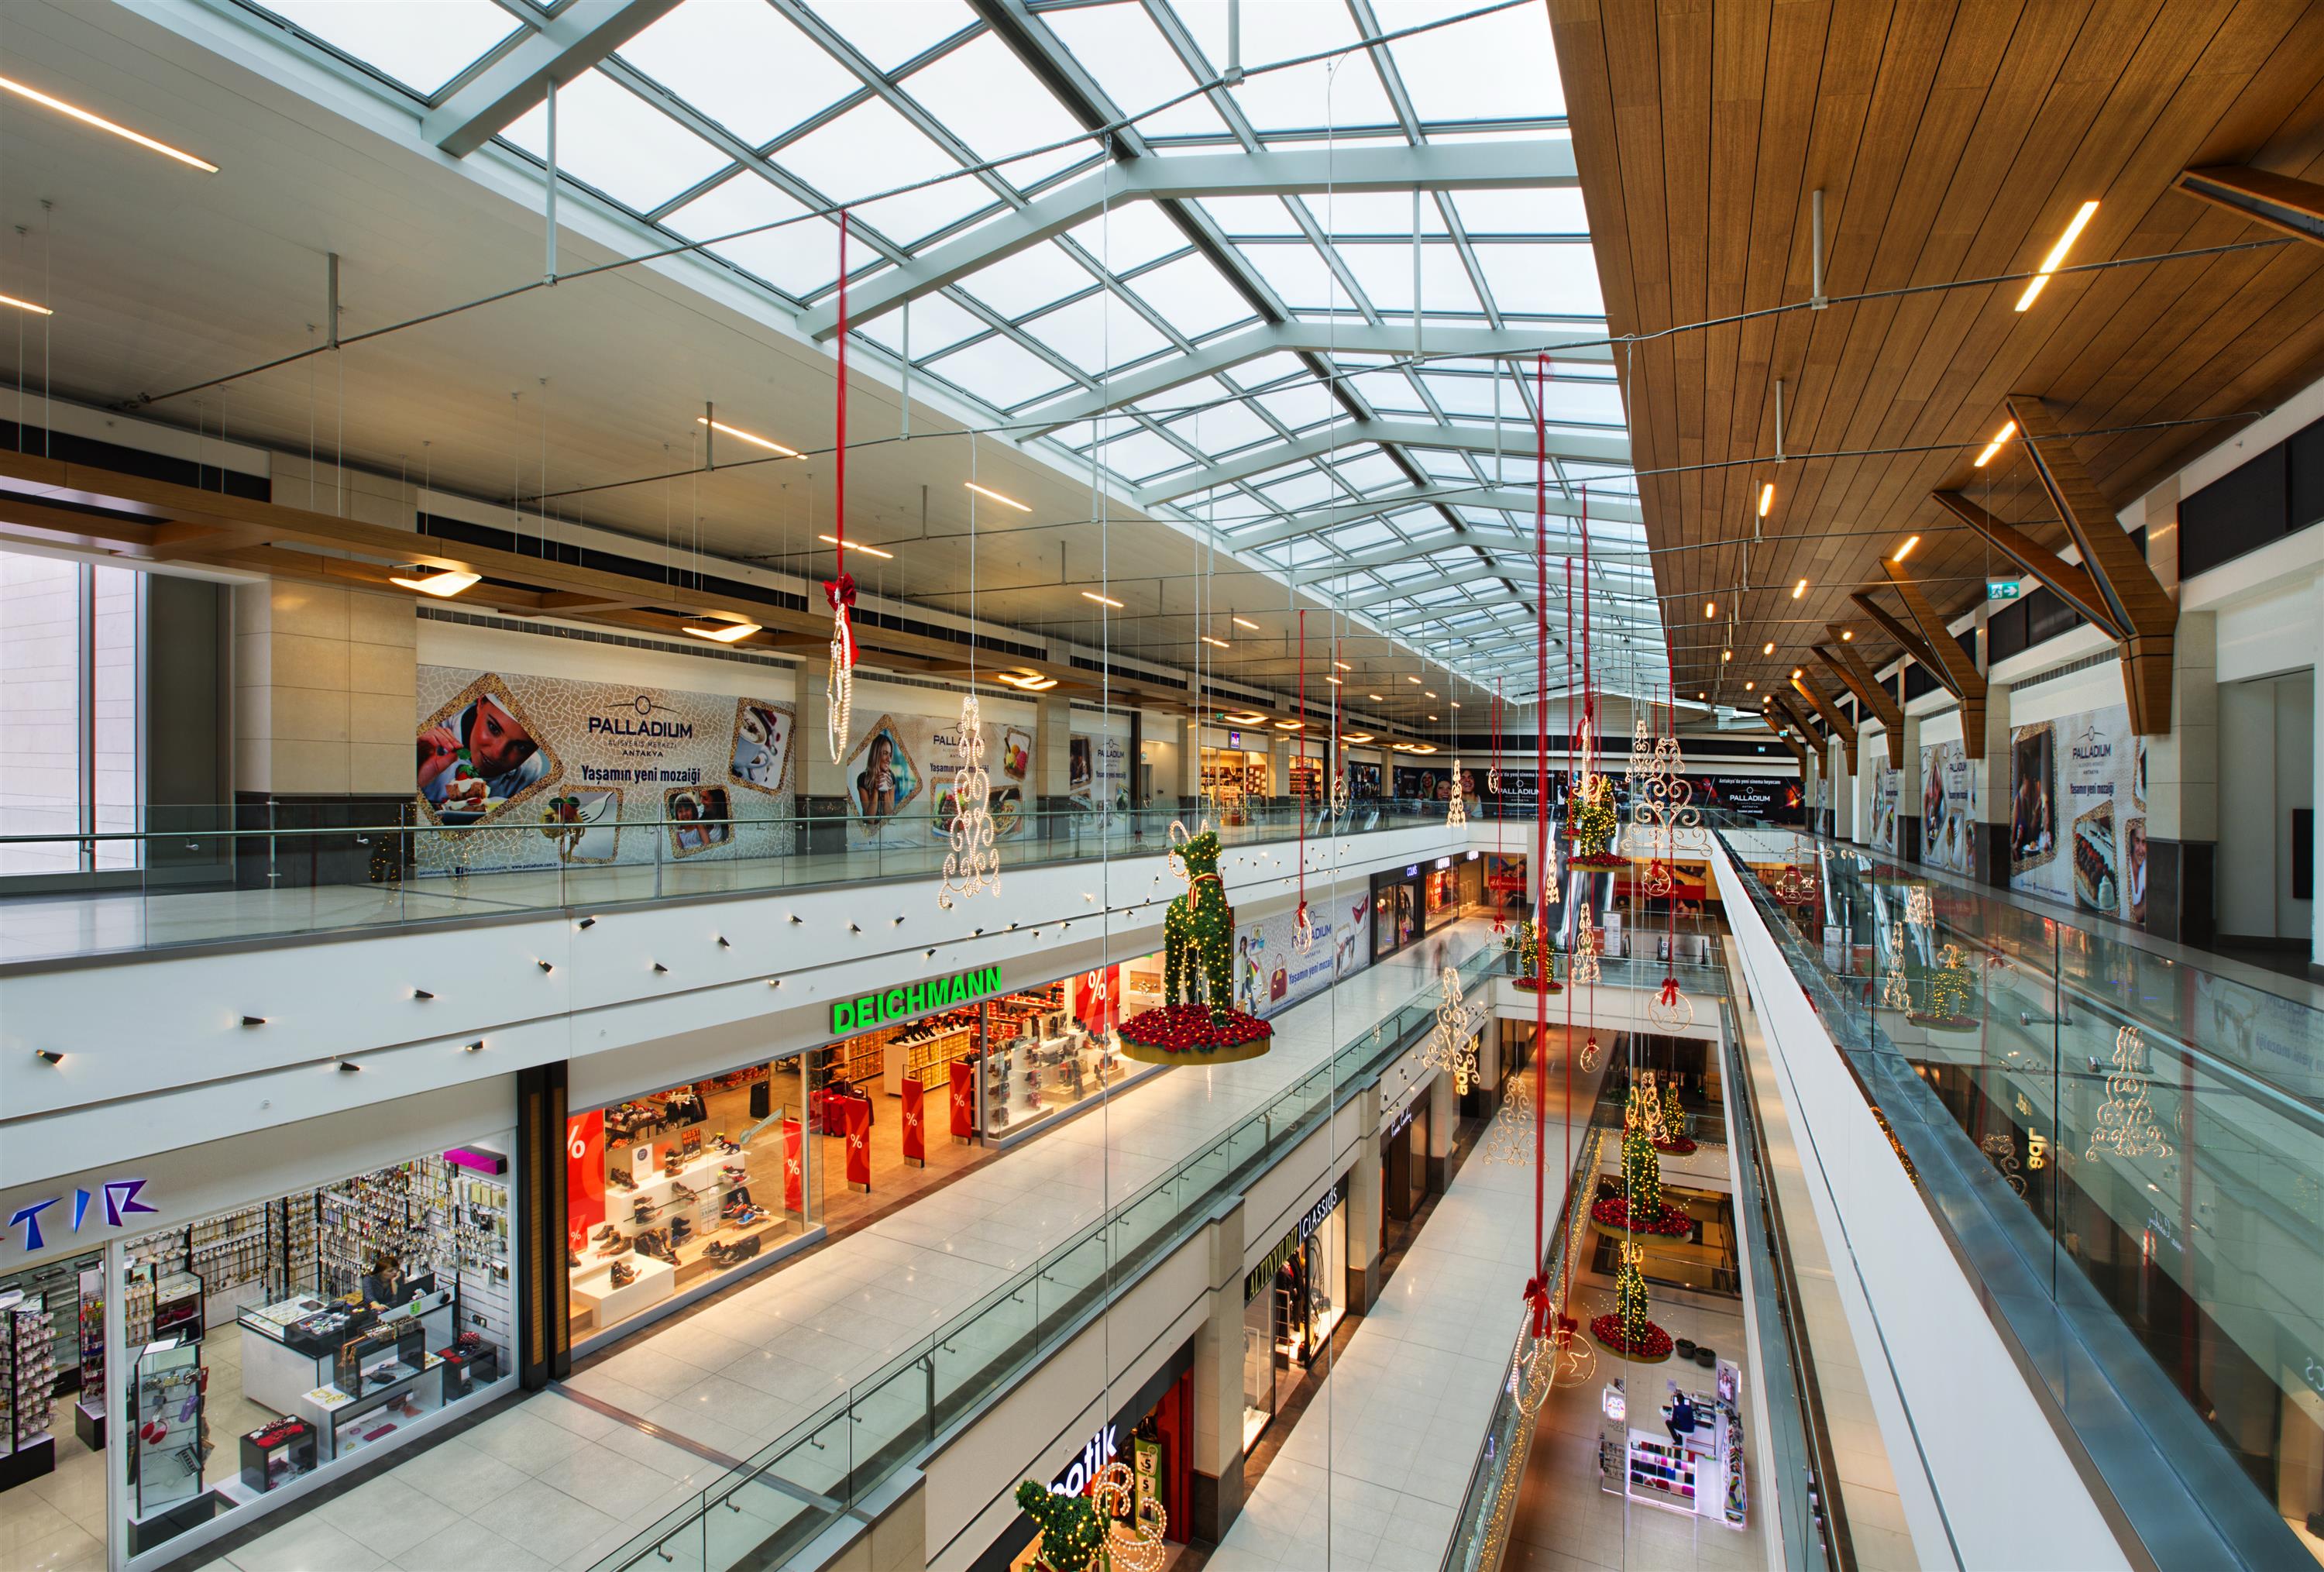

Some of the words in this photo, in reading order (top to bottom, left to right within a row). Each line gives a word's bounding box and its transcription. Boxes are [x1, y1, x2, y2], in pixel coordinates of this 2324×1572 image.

[589, 717, 693, 738] PALLADIUM
[1098, 749, 1125, 758] PALADIUM
[2073, 744, 2111, 759] PALLADIUM
[582, 765, 631, 785] Yaşamın
[634, 767, 658, 784] yeni
[660, 768, 701, 785] mozaiği
[930, 763, 954, 774] Yaşamın
[1291, 924, 1332, 948] PLADIUM
[1289, 968, 1308, 985] Yaşamın
[1308, 962, 1318, 979] yeni
[834, 966, 1002, 1035] DEICHMANN
[0, 1178, 160, 1251] TIR
[1250, 1226, 1298, 1301] ALTINYILDIZ
[1302, 1187, 1337, 1237] CLASSICS
